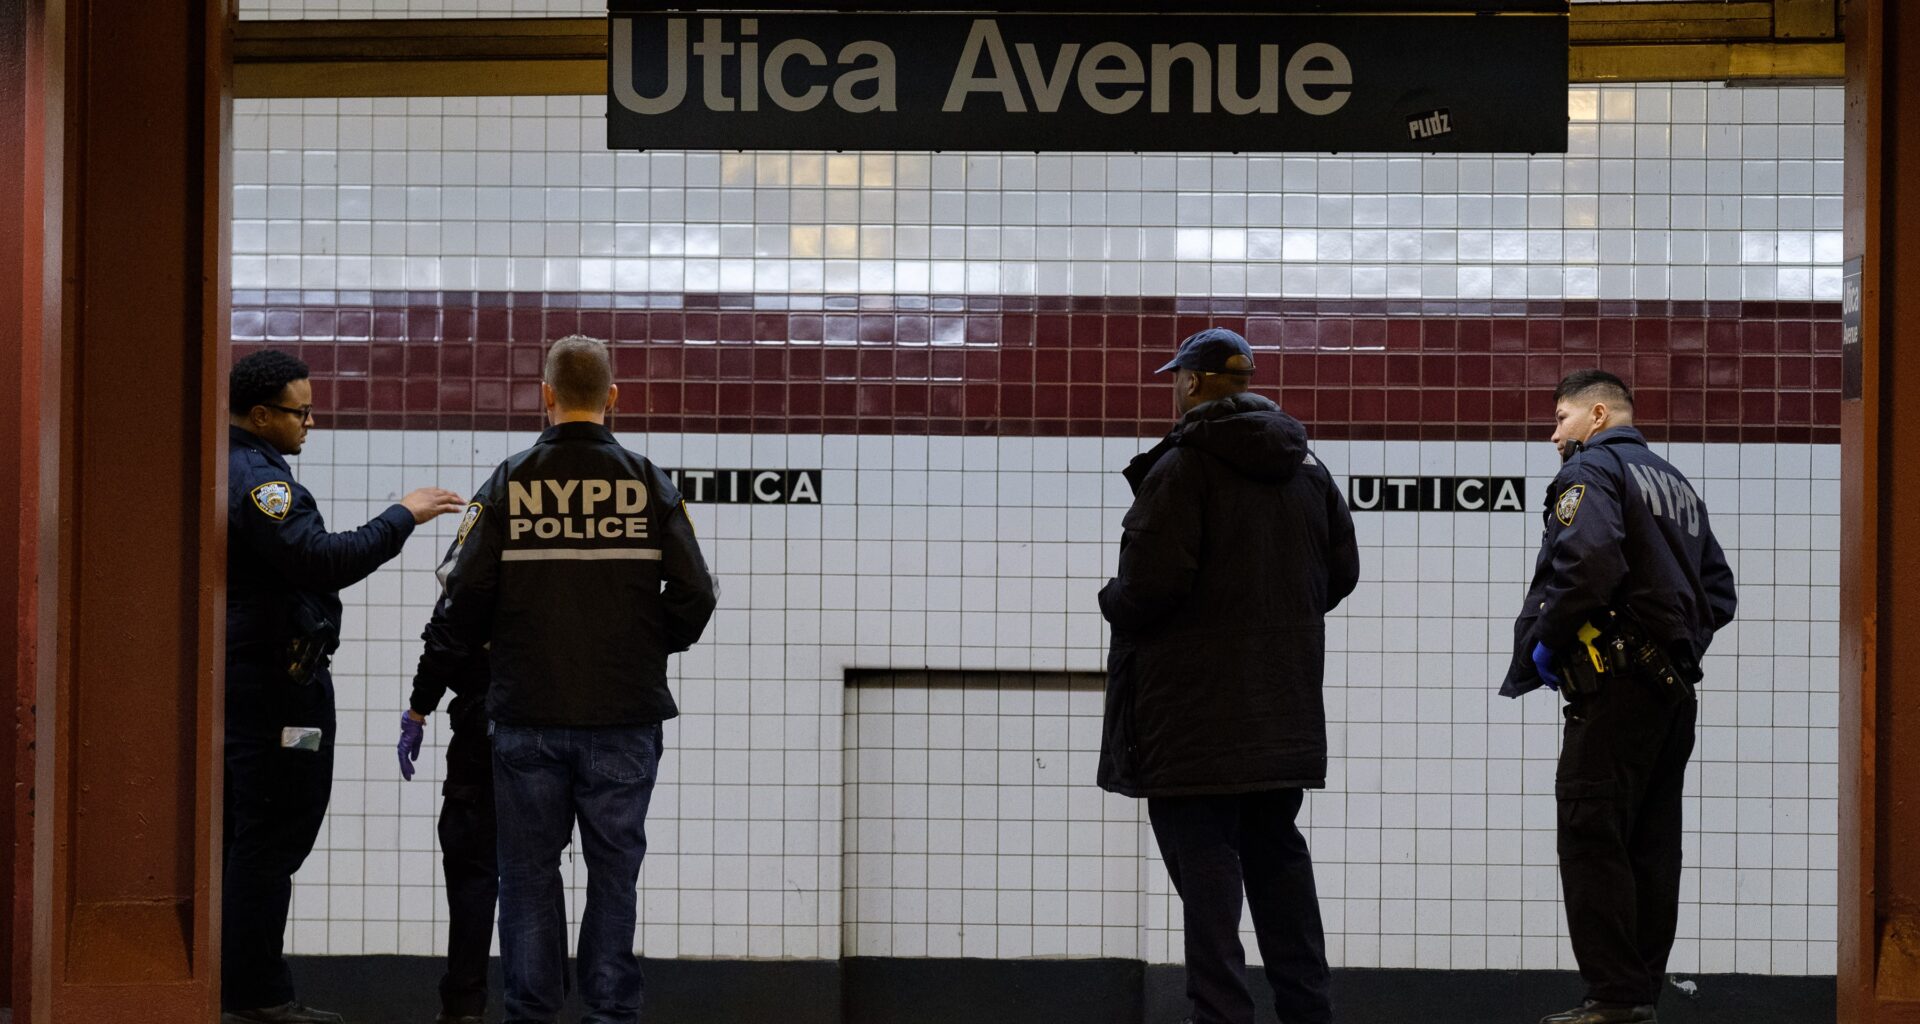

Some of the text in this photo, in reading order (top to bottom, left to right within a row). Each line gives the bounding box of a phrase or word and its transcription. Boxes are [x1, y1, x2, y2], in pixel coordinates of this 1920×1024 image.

[612, 17, 1353, 115] Utica Avenue
[509, 480, 648, 516] NYPD
[671, 470, 819, 502] TICA
[1352, 478, 1522, 510] UTICA
[1627, 463, 1700, 537] NYPD
[509, 517, 648, 540] POLICE
